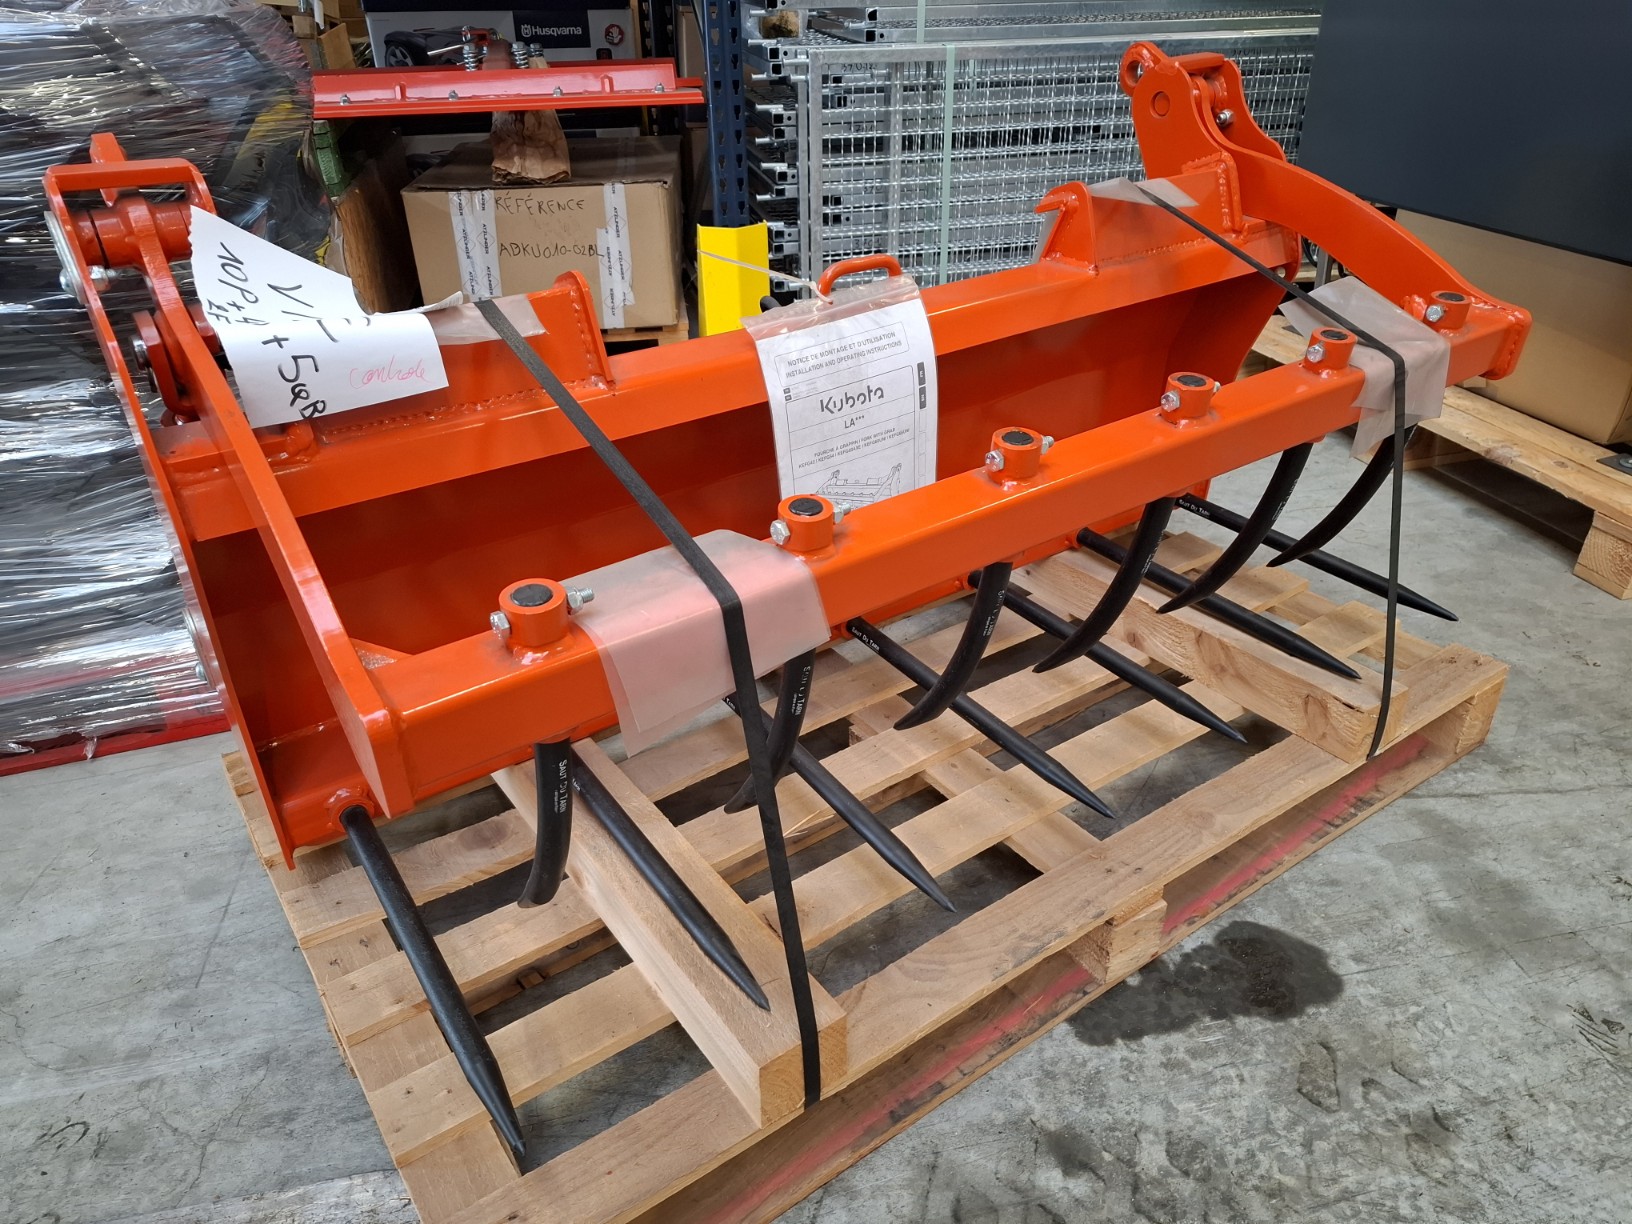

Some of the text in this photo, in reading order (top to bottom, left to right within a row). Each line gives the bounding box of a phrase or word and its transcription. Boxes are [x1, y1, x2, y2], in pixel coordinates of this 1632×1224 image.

[531, 25, 582, 37] Husqvarna
[495, 191, 585, 216] RÉFÉRENCE
[785, 340, 902, 379] INSTALLATION AND OPERATING INSTRUCTIONS
[787, 356, 810, 367] NOTICE
[811, 353, 819, 361] DE
[819, 346, 848, 358] MONTAGE
[857, 331, 896, 347] D'UTILISATION
[819, 385, 885, 415] Kubota
[559, 759, 568, 779] SAUT
[559, 793, 568, 813] TARN
